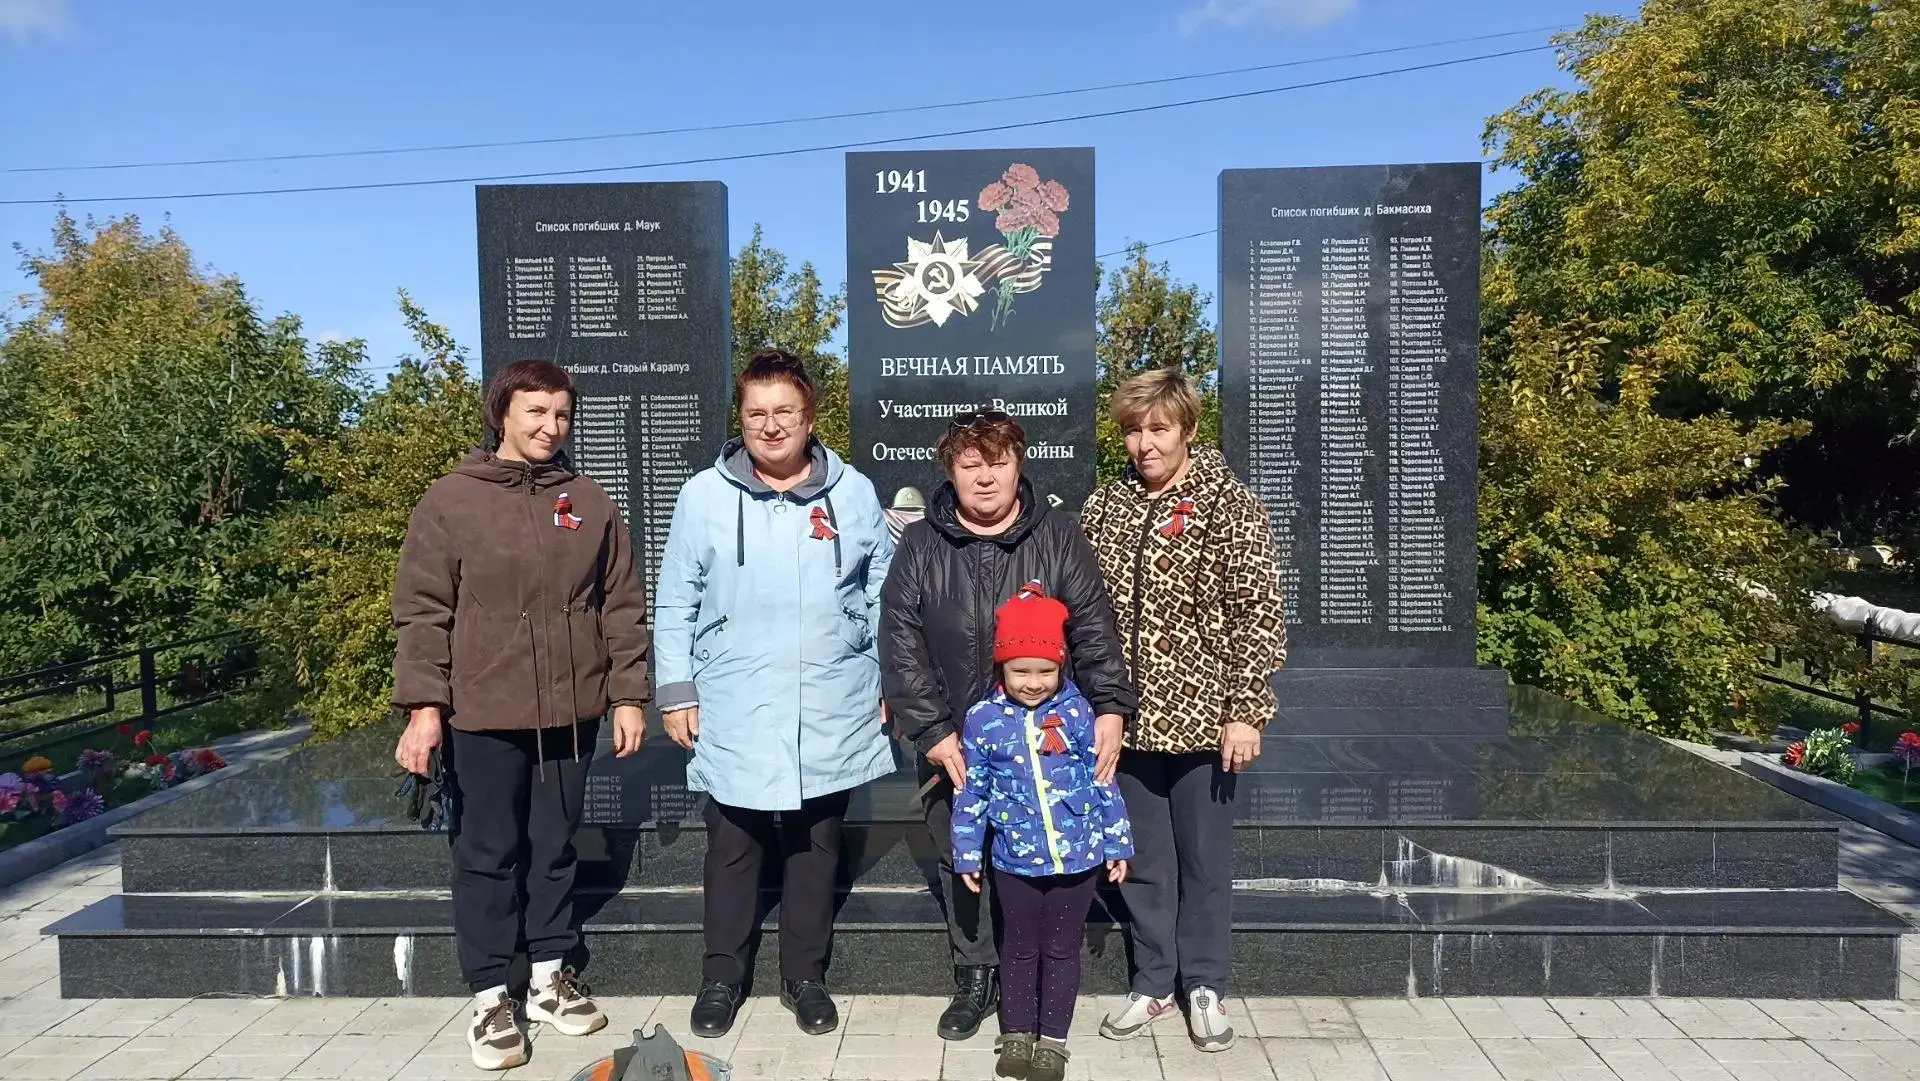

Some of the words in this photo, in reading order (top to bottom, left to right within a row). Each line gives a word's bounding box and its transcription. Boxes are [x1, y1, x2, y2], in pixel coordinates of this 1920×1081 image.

[875, 170, 926, 193] 1941
[918, 200, 969, 222] 1945
[1272, 207, 1307, 217] Список
[1310, 206, 1359, 216] погибших
[1364, 207, 1374, 217] д.
[1377, 204, 1431, 214] Бакмасиха
[536, 222, 570, 232] Список
[573, 221, 620, 231] погибших
[624, 222, 633, 231] д.
[636, 220, 660, 232] Маук
[560, 363, 599, 374] гибших
[601, 365, 609, 374] д.
[612, 362, 647, 374] Старый
[881, 357, 967, 377] ВЕЧНАЯ
[974, 355, 1064, 375] ПАМЯТЬ
[992, 398, 1067, 417] Великой
[1025, 442, 1074, 459] ойны
